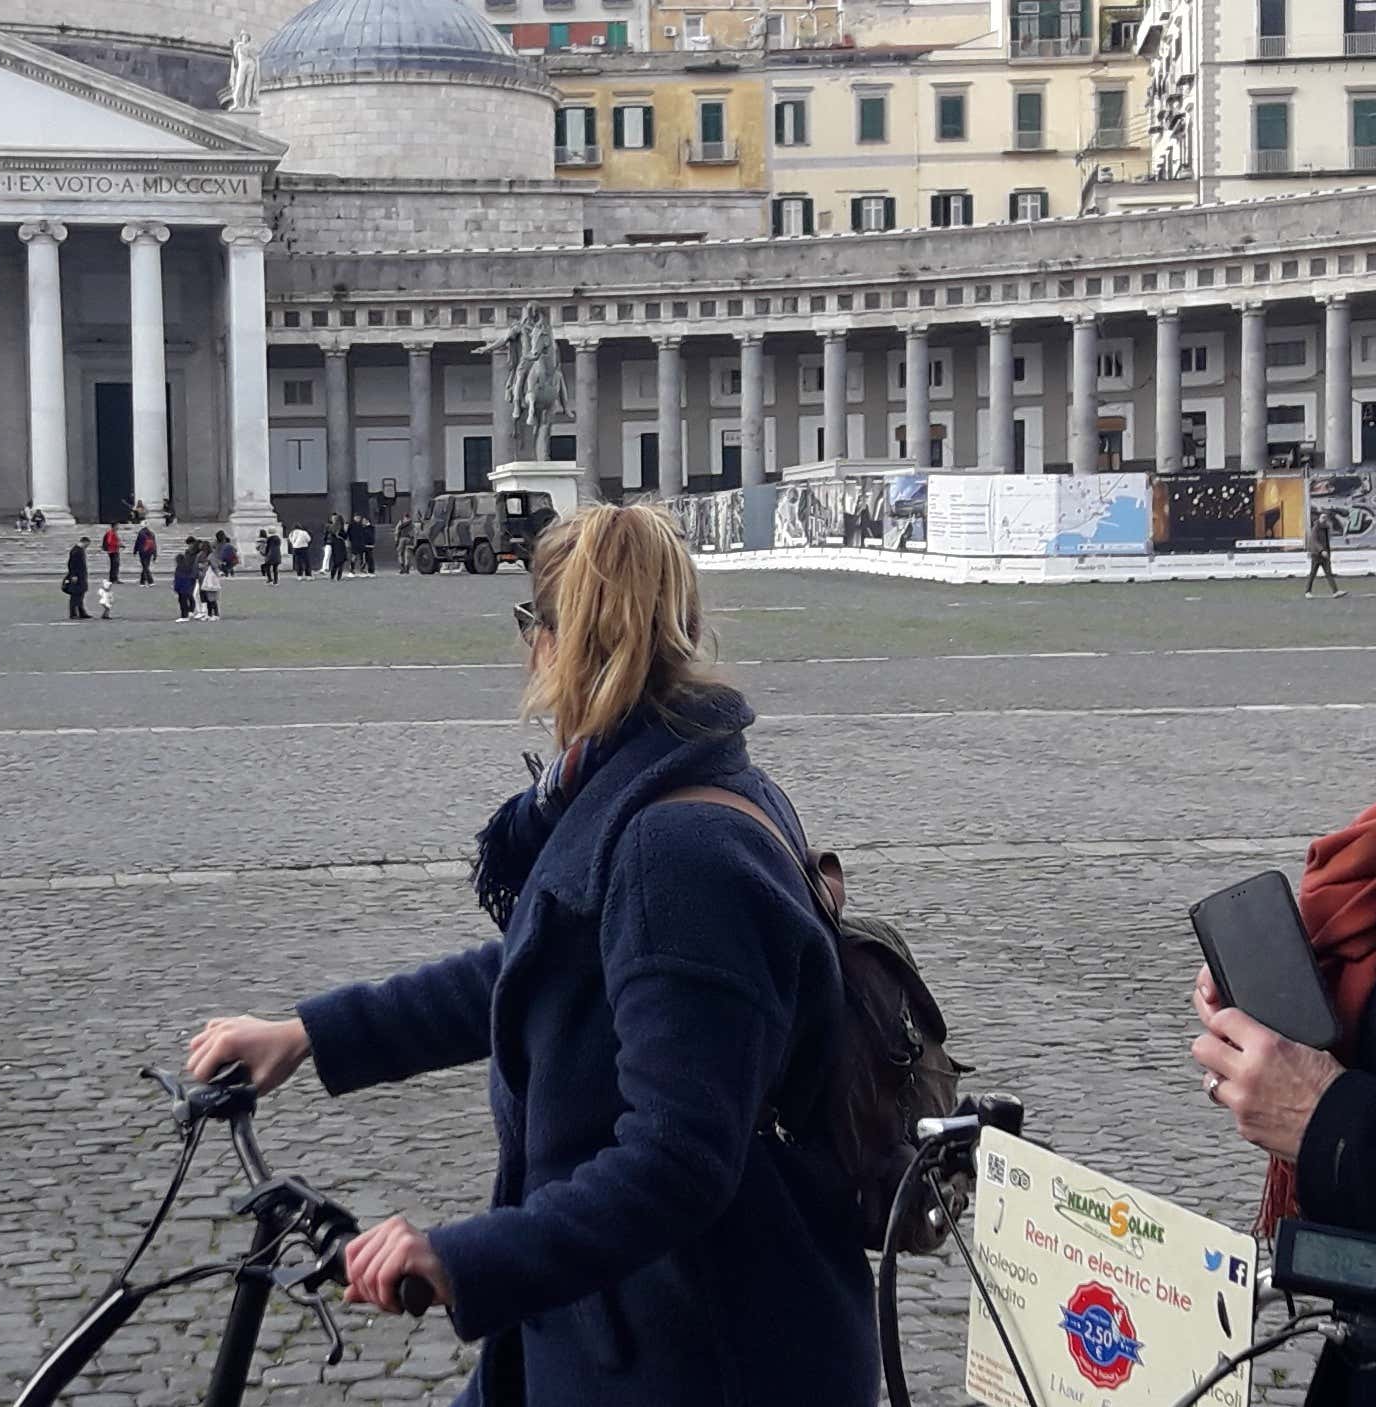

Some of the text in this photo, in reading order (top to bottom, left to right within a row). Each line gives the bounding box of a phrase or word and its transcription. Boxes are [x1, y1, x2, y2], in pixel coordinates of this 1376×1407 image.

[19, 175, 45, 192] EX
[54, 175, 112, 193] VOTO
[1024, 1218, 1059, 1254] Rent
[1063, 1243, 1084, 1265] an
[1087, 1250, 1151, 1295] electric
[1156, 1276, 1193, 1312] bike
